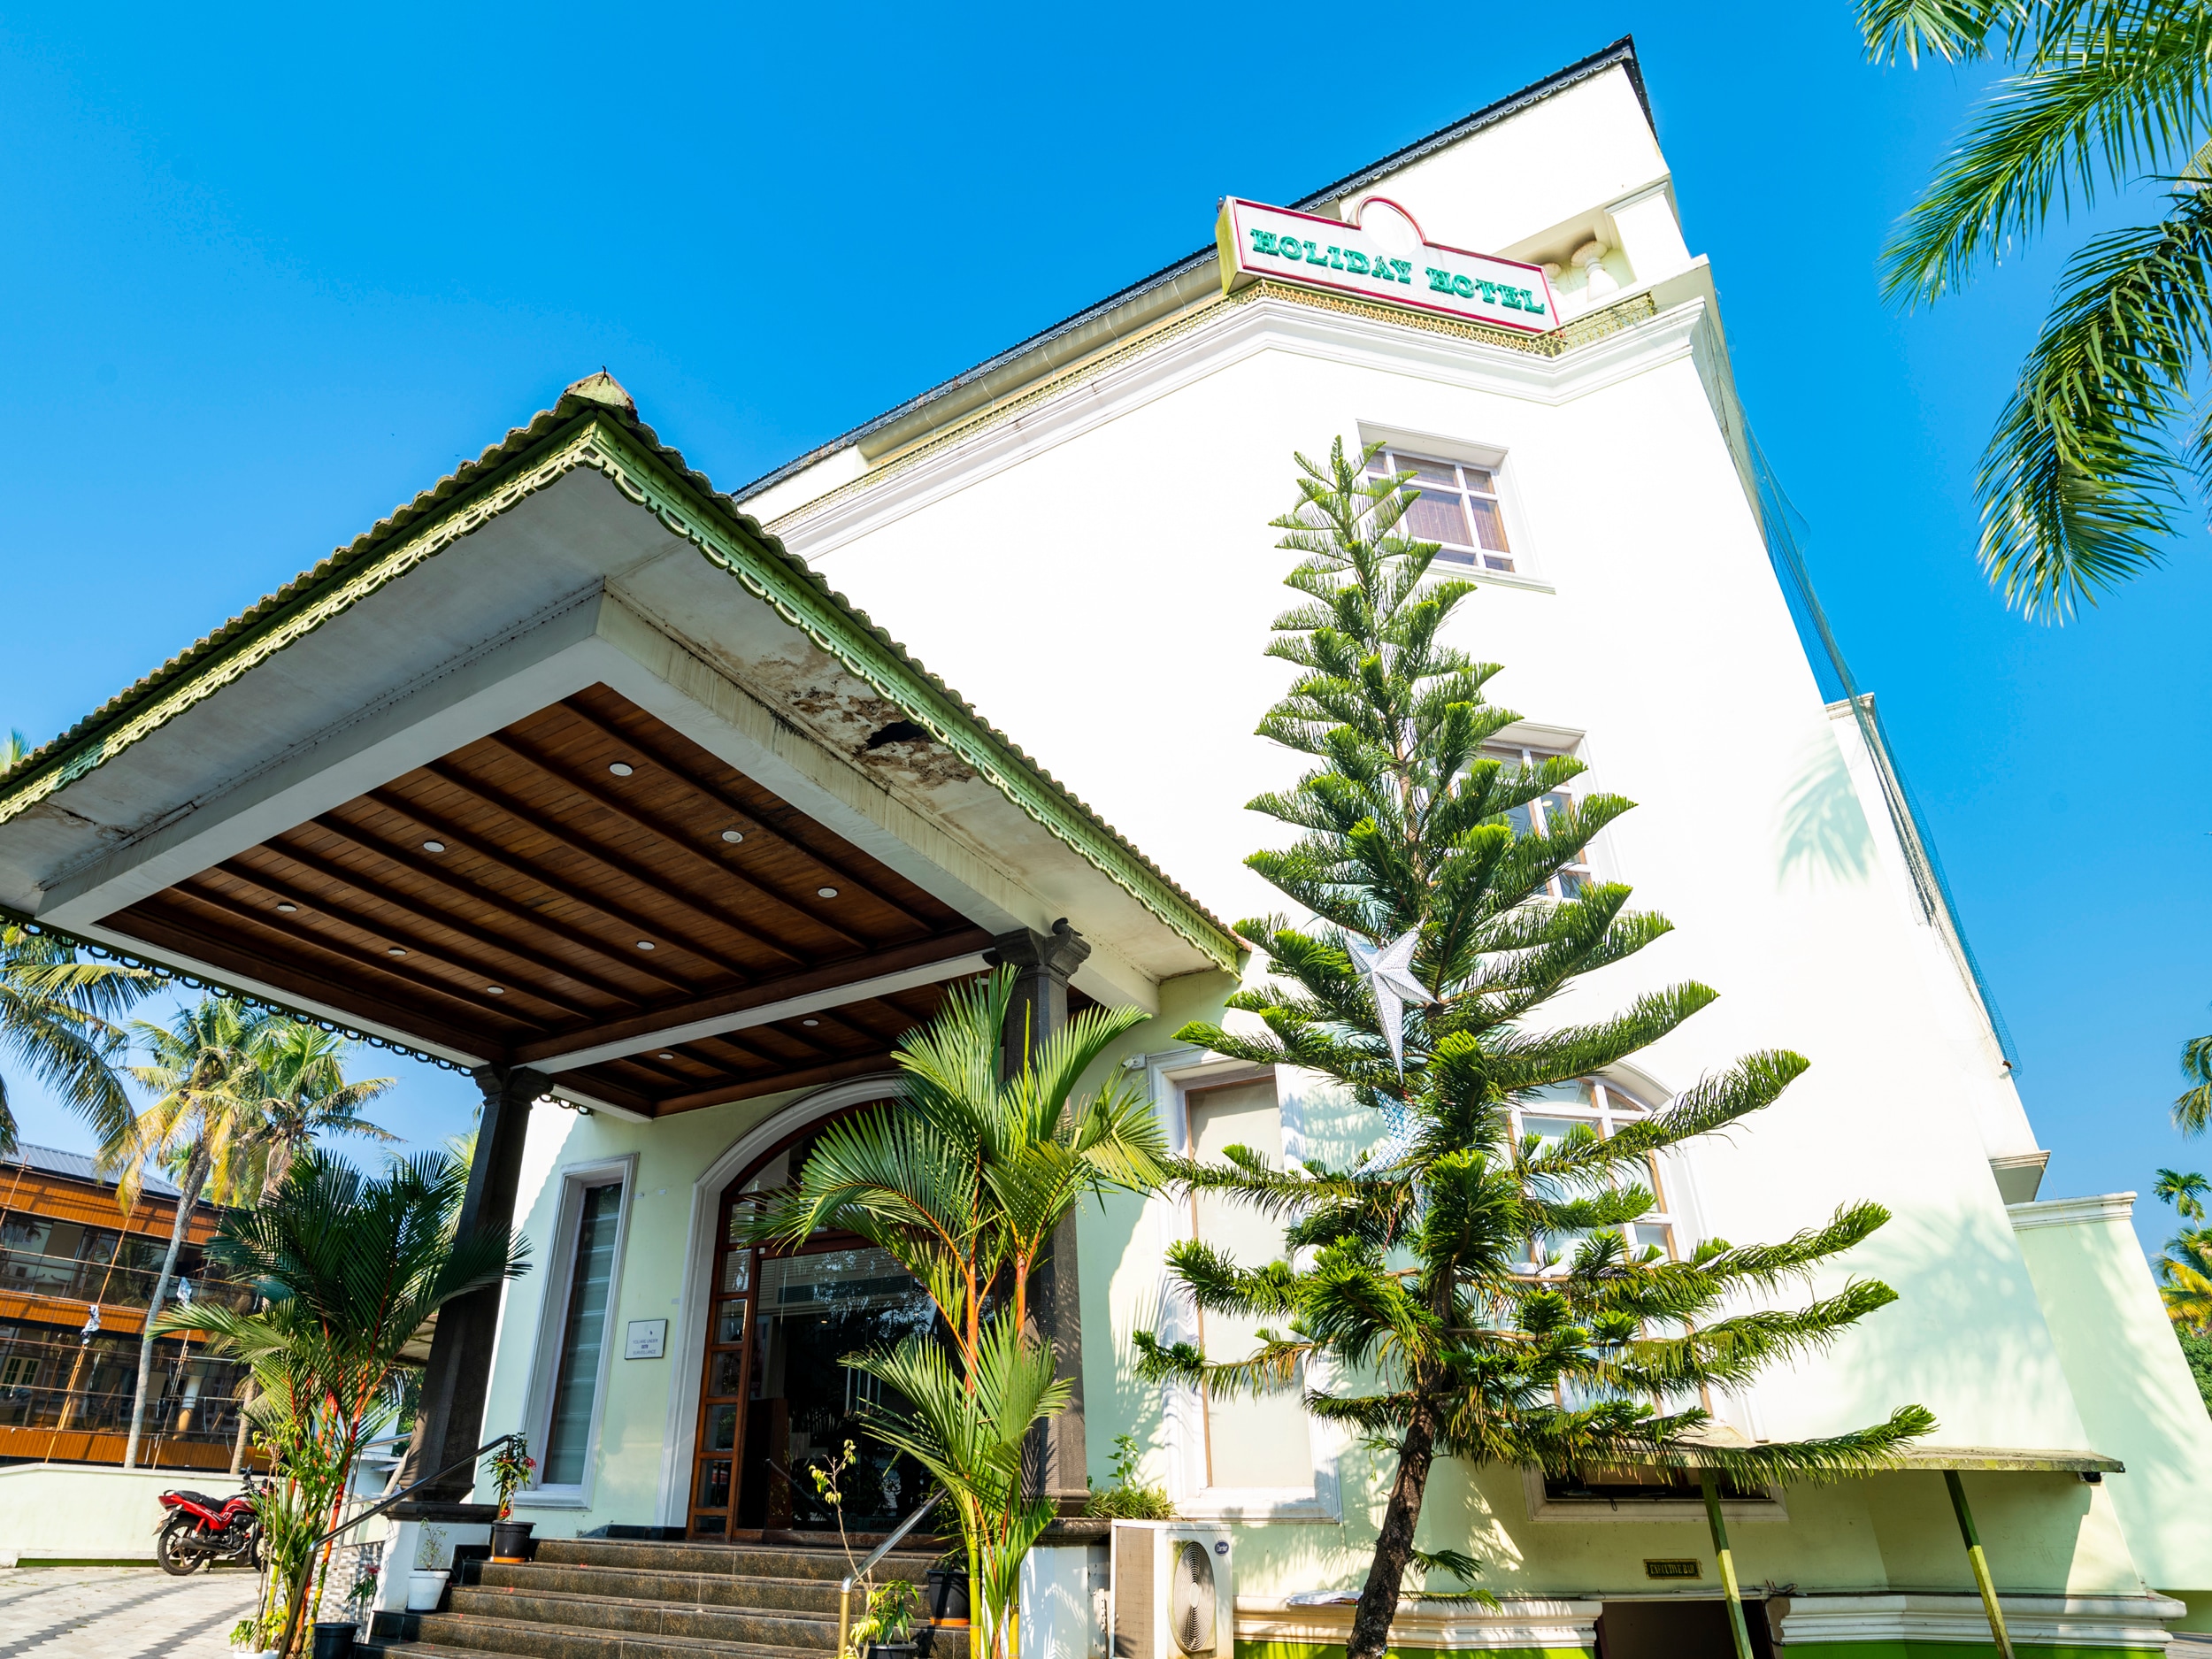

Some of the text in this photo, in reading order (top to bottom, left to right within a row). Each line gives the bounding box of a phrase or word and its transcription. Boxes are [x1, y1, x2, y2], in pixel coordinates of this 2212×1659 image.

[1249, 228, 1413, 283] HOLIDAY
[1425, 266, 1546, 315] HOTEL
[1649, 1563, 1695, 1575] EXECUTIVE BAR
